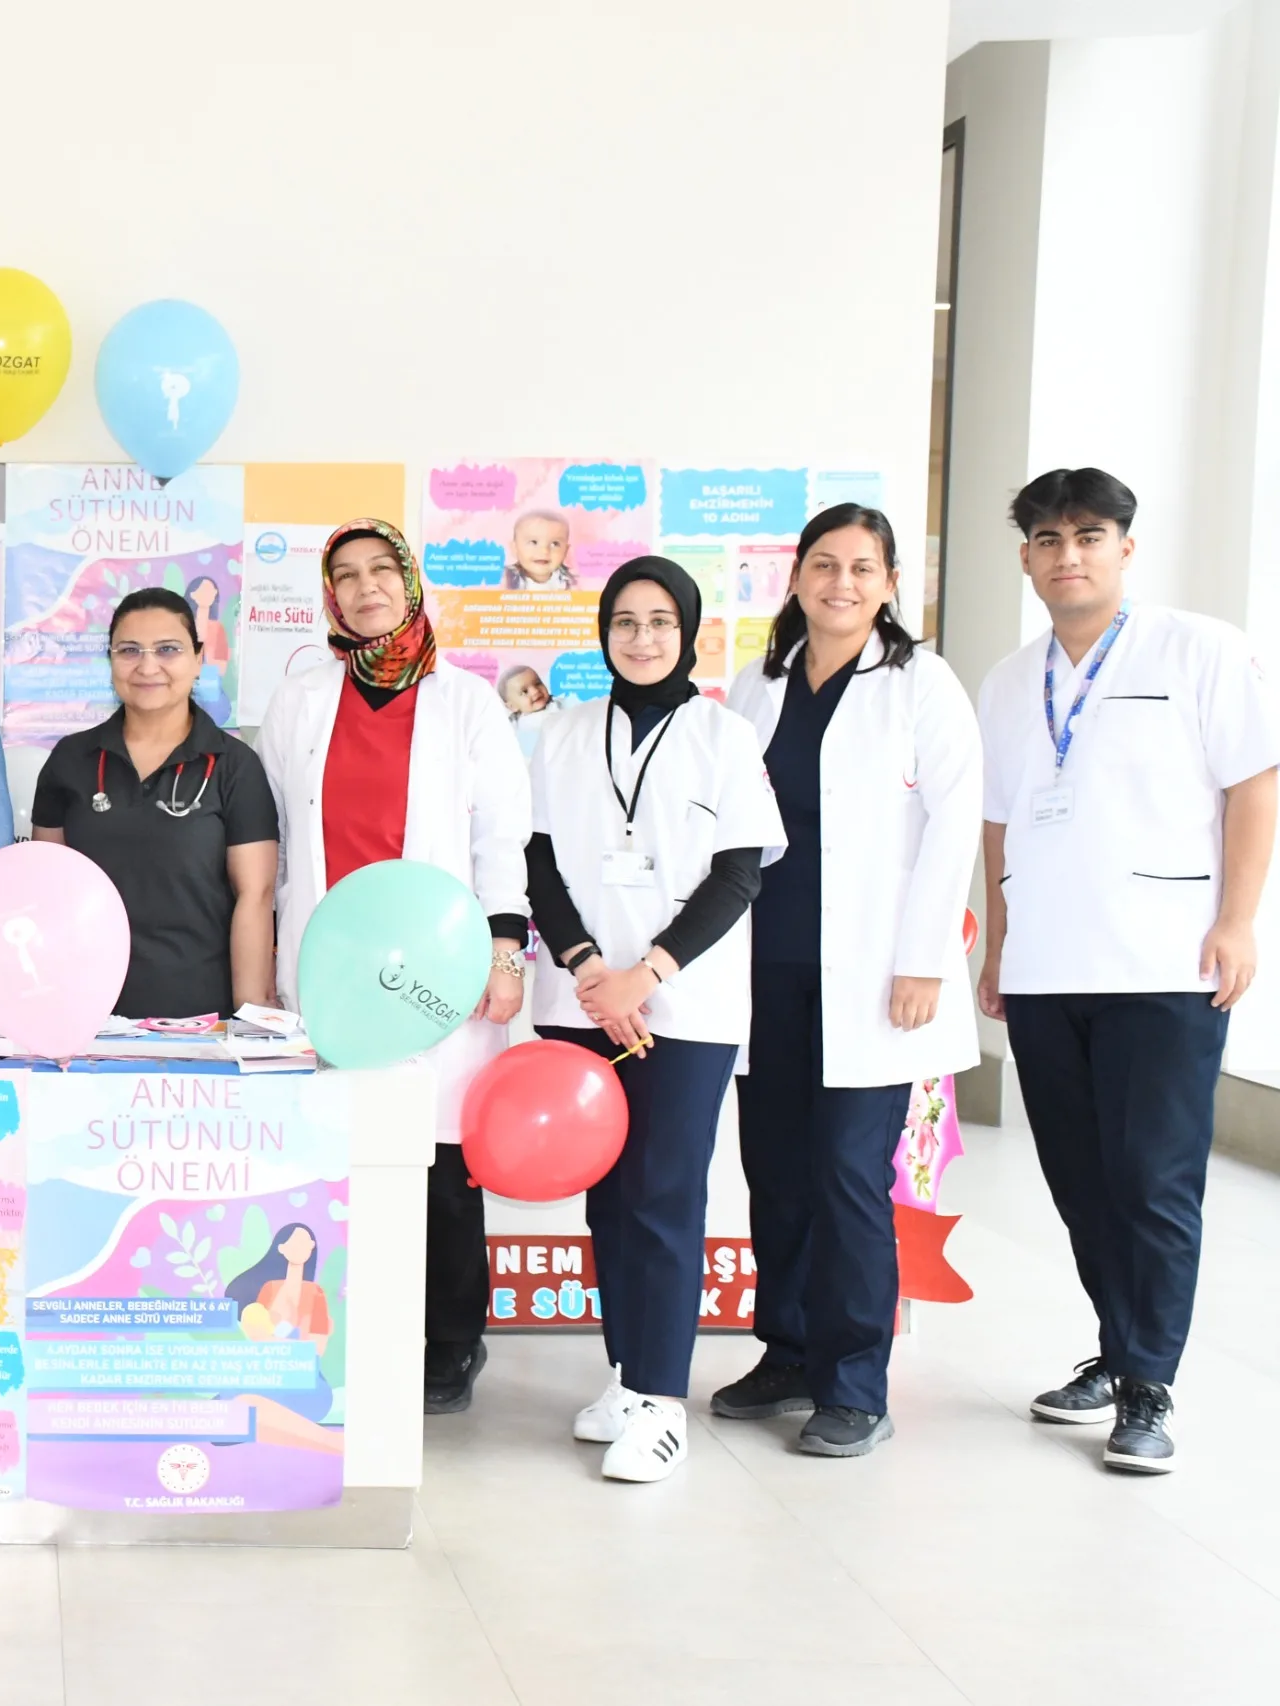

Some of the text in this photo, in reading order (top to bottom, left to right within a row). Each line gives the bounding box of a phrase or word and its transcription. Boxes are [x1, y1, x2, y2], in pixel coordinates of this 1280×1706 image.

[689, 497, 774, 510] EMZİRMENİN
[702, 485, 761, 499] BAŞARILI
[48, 494, 195, 523] SÜTÜNÜN
[702, 512, 760, 524] 10 ADIMI
[71, 525, 170, 553] ÖNEMİ
[249, 605, 314, 624] Anne Sütü
[409, 979, 461, 1023] YOZGAT
[130, 1078, 242, 1110] ANNE
[86, 1114, 284, 1151] SÜTÜNÜN
[117, 1155, 251, 1192] ÖNEMİ
[486, 1245, 582, 1276] NEM
[33, 1298, 231, 1313] SEVGİLİ ANNELER, BEBEĞİNİZE İLK 6 AY
[60, 1311, 203, 1325] SADECE ANNE SÜTÜ VERİNİZ
[124, 1495, 246, 1509] T.C. SAĞLIK BAKANLIĞI
